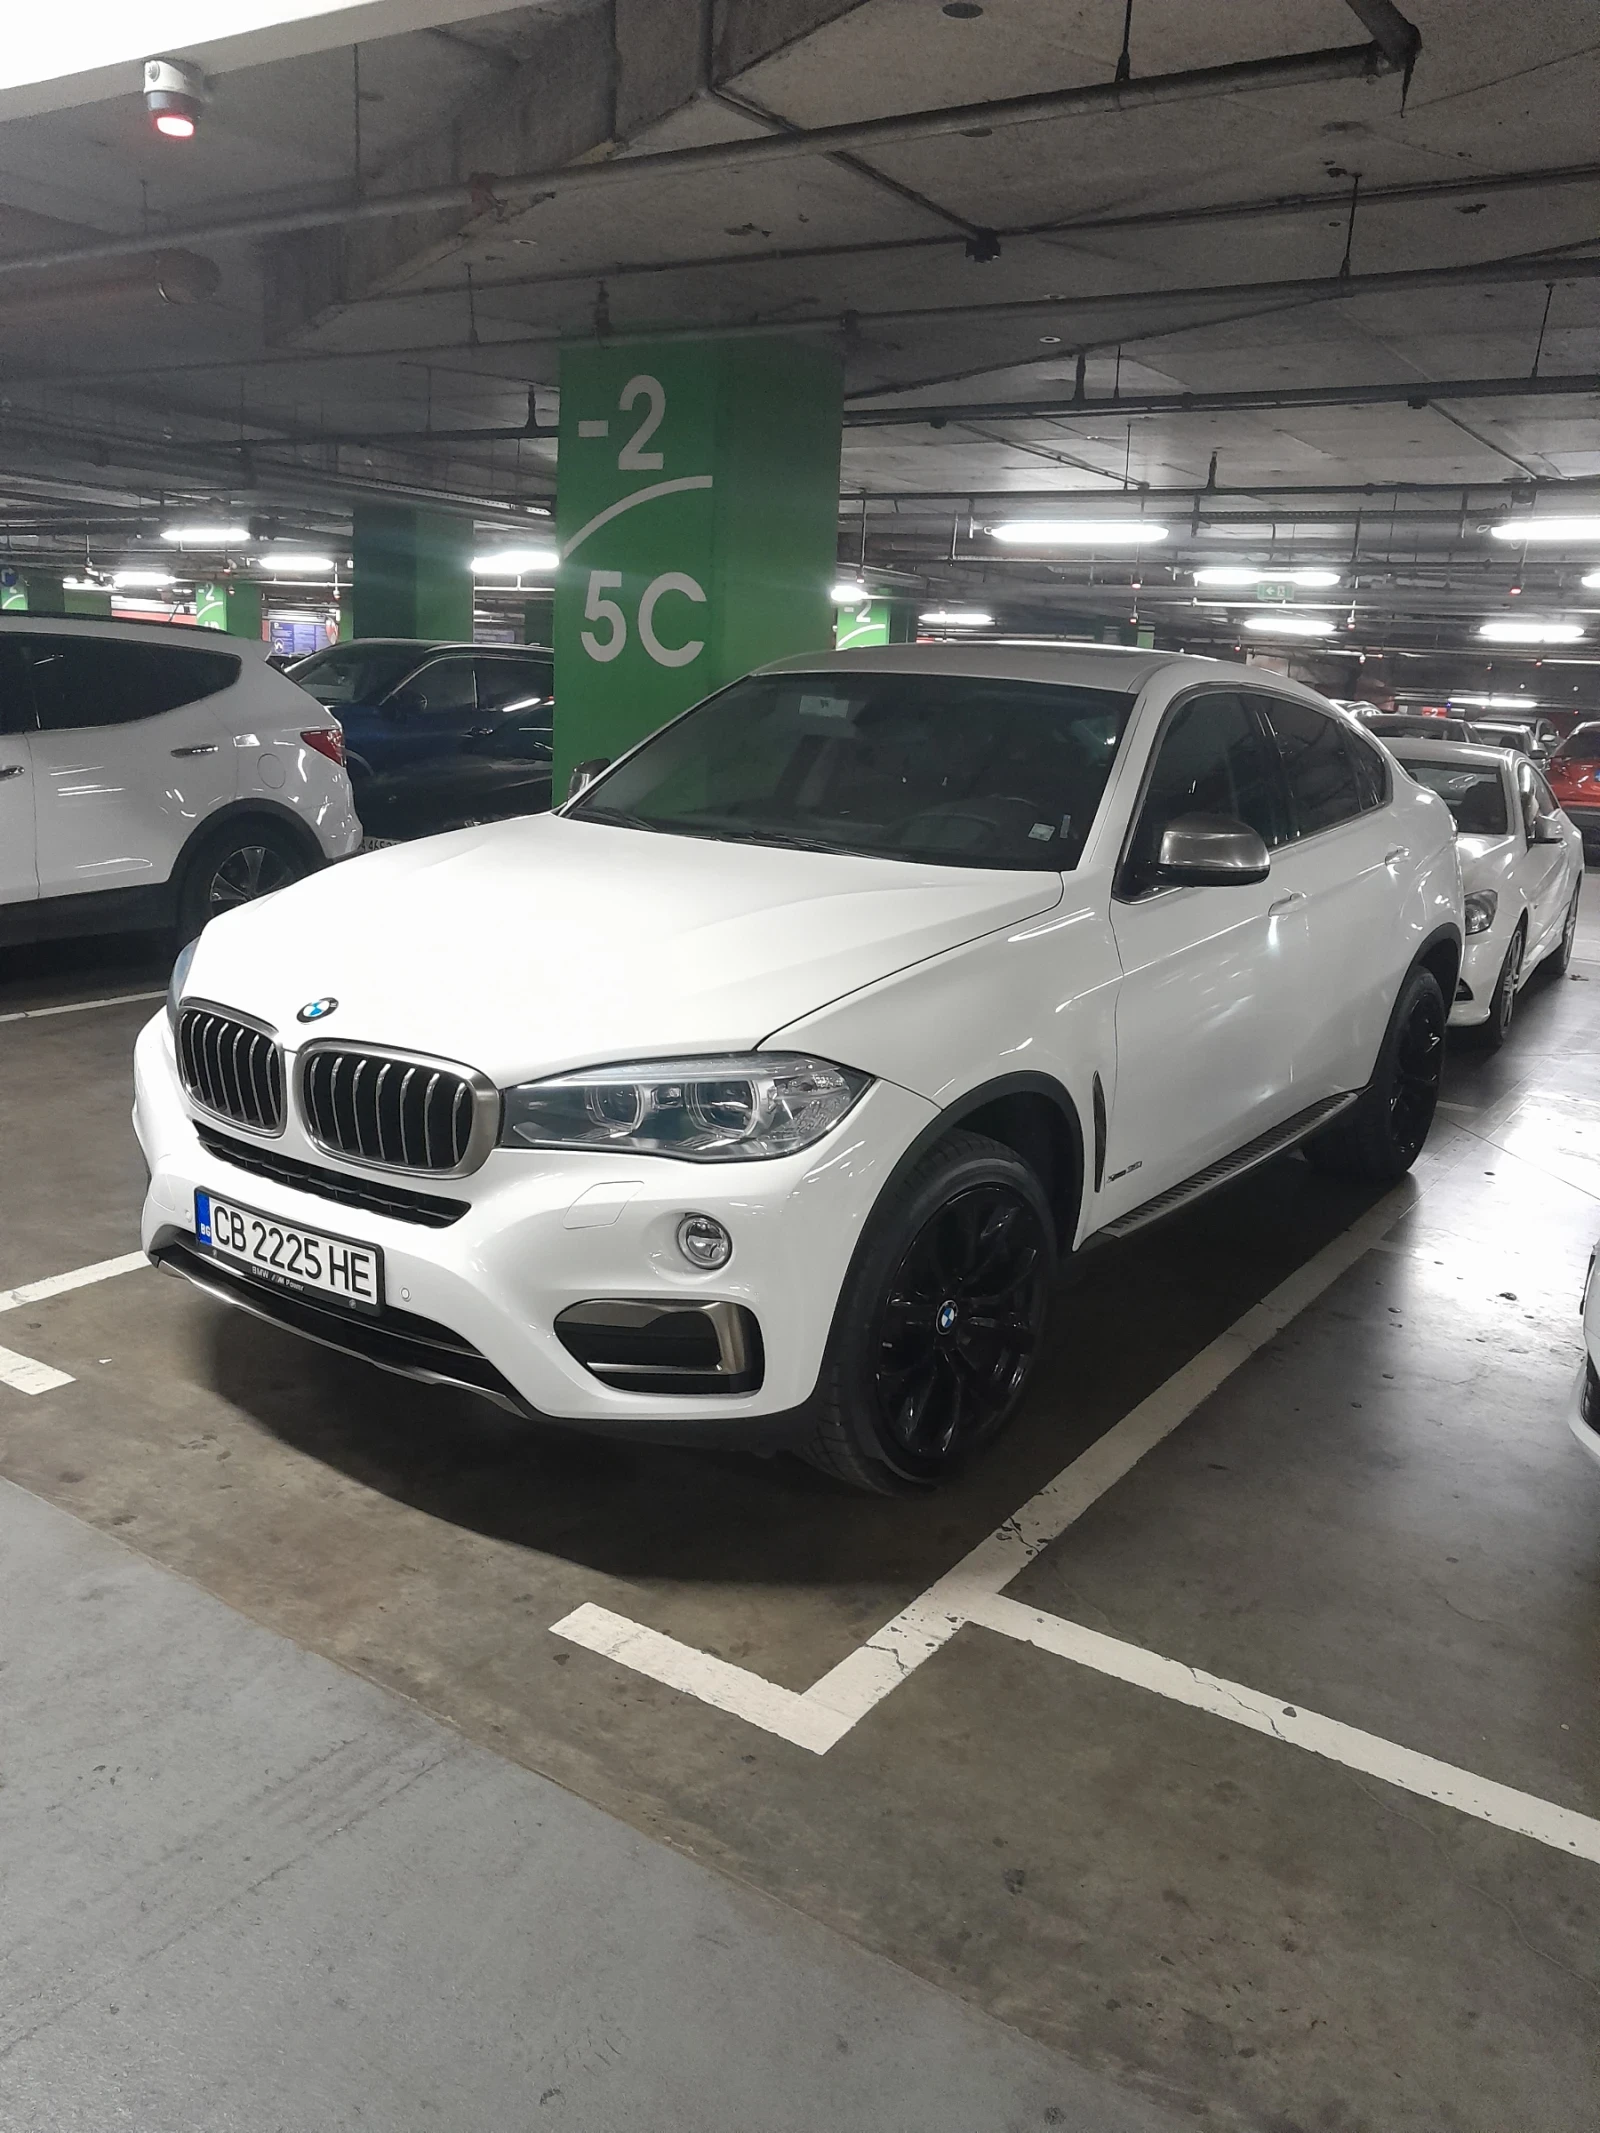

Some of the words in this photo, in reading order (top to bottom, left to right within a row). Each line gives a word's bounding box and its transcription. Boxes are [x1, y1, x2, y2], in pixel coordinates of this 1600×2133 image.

[578, 374, 667, 470] -2
[580, 570, 708, 668] 5C
[844, 599, 872, 623] -2
[200, 1222, 211, 1238] BG
[213, 1205, 247, 1252] CB
[251, 1220, 323, 1280] 2225
[328, 1245, 372, 1298] HE
[251, 1265, 269, 1279] BMW
